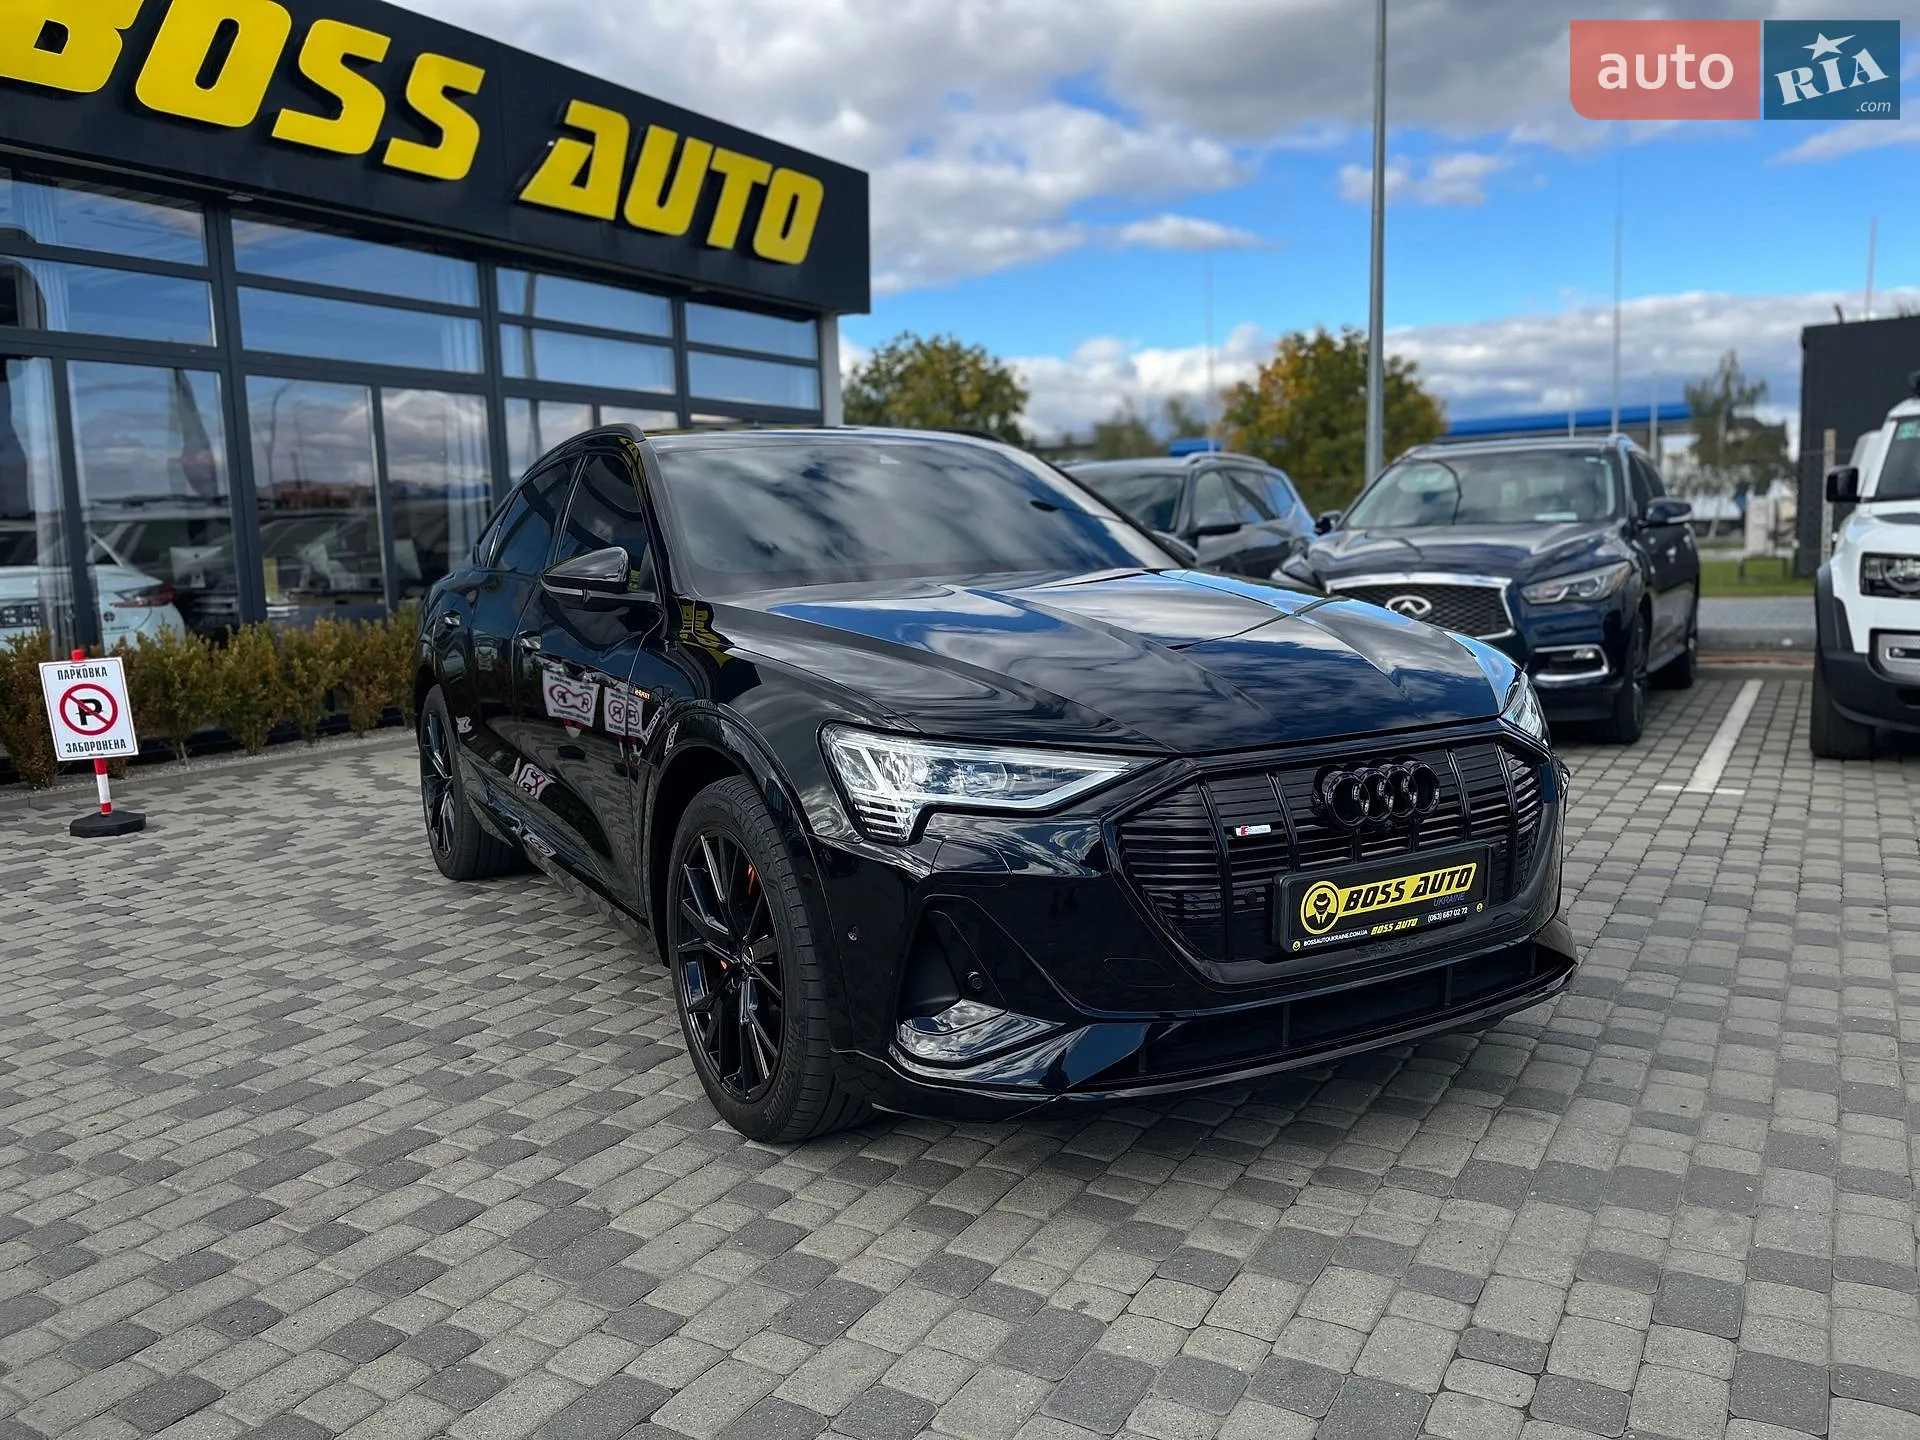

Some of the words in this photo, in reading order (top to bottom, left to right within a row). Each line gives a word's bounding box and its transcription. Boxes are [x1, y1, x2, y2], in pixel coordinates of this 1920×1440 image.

[0, 0, 486, 181] BOSS
[519, 99, 825, 266] AUTO
[57, 666, 109, 681] ПАРКОВКА
[65, 738, 127, 754] ЗАБОРОНЕНА
[1342, 879, 1407, 913] BOSS
[1410, 866, 1474, 899] AUTO
[1433, 892, 1466, 907] UKRAINE
[1453, 908, 1461, 917] 02
[1370, 922, 1394, 936] BOSS
[1395, 918, 1418, 931] AUTO
